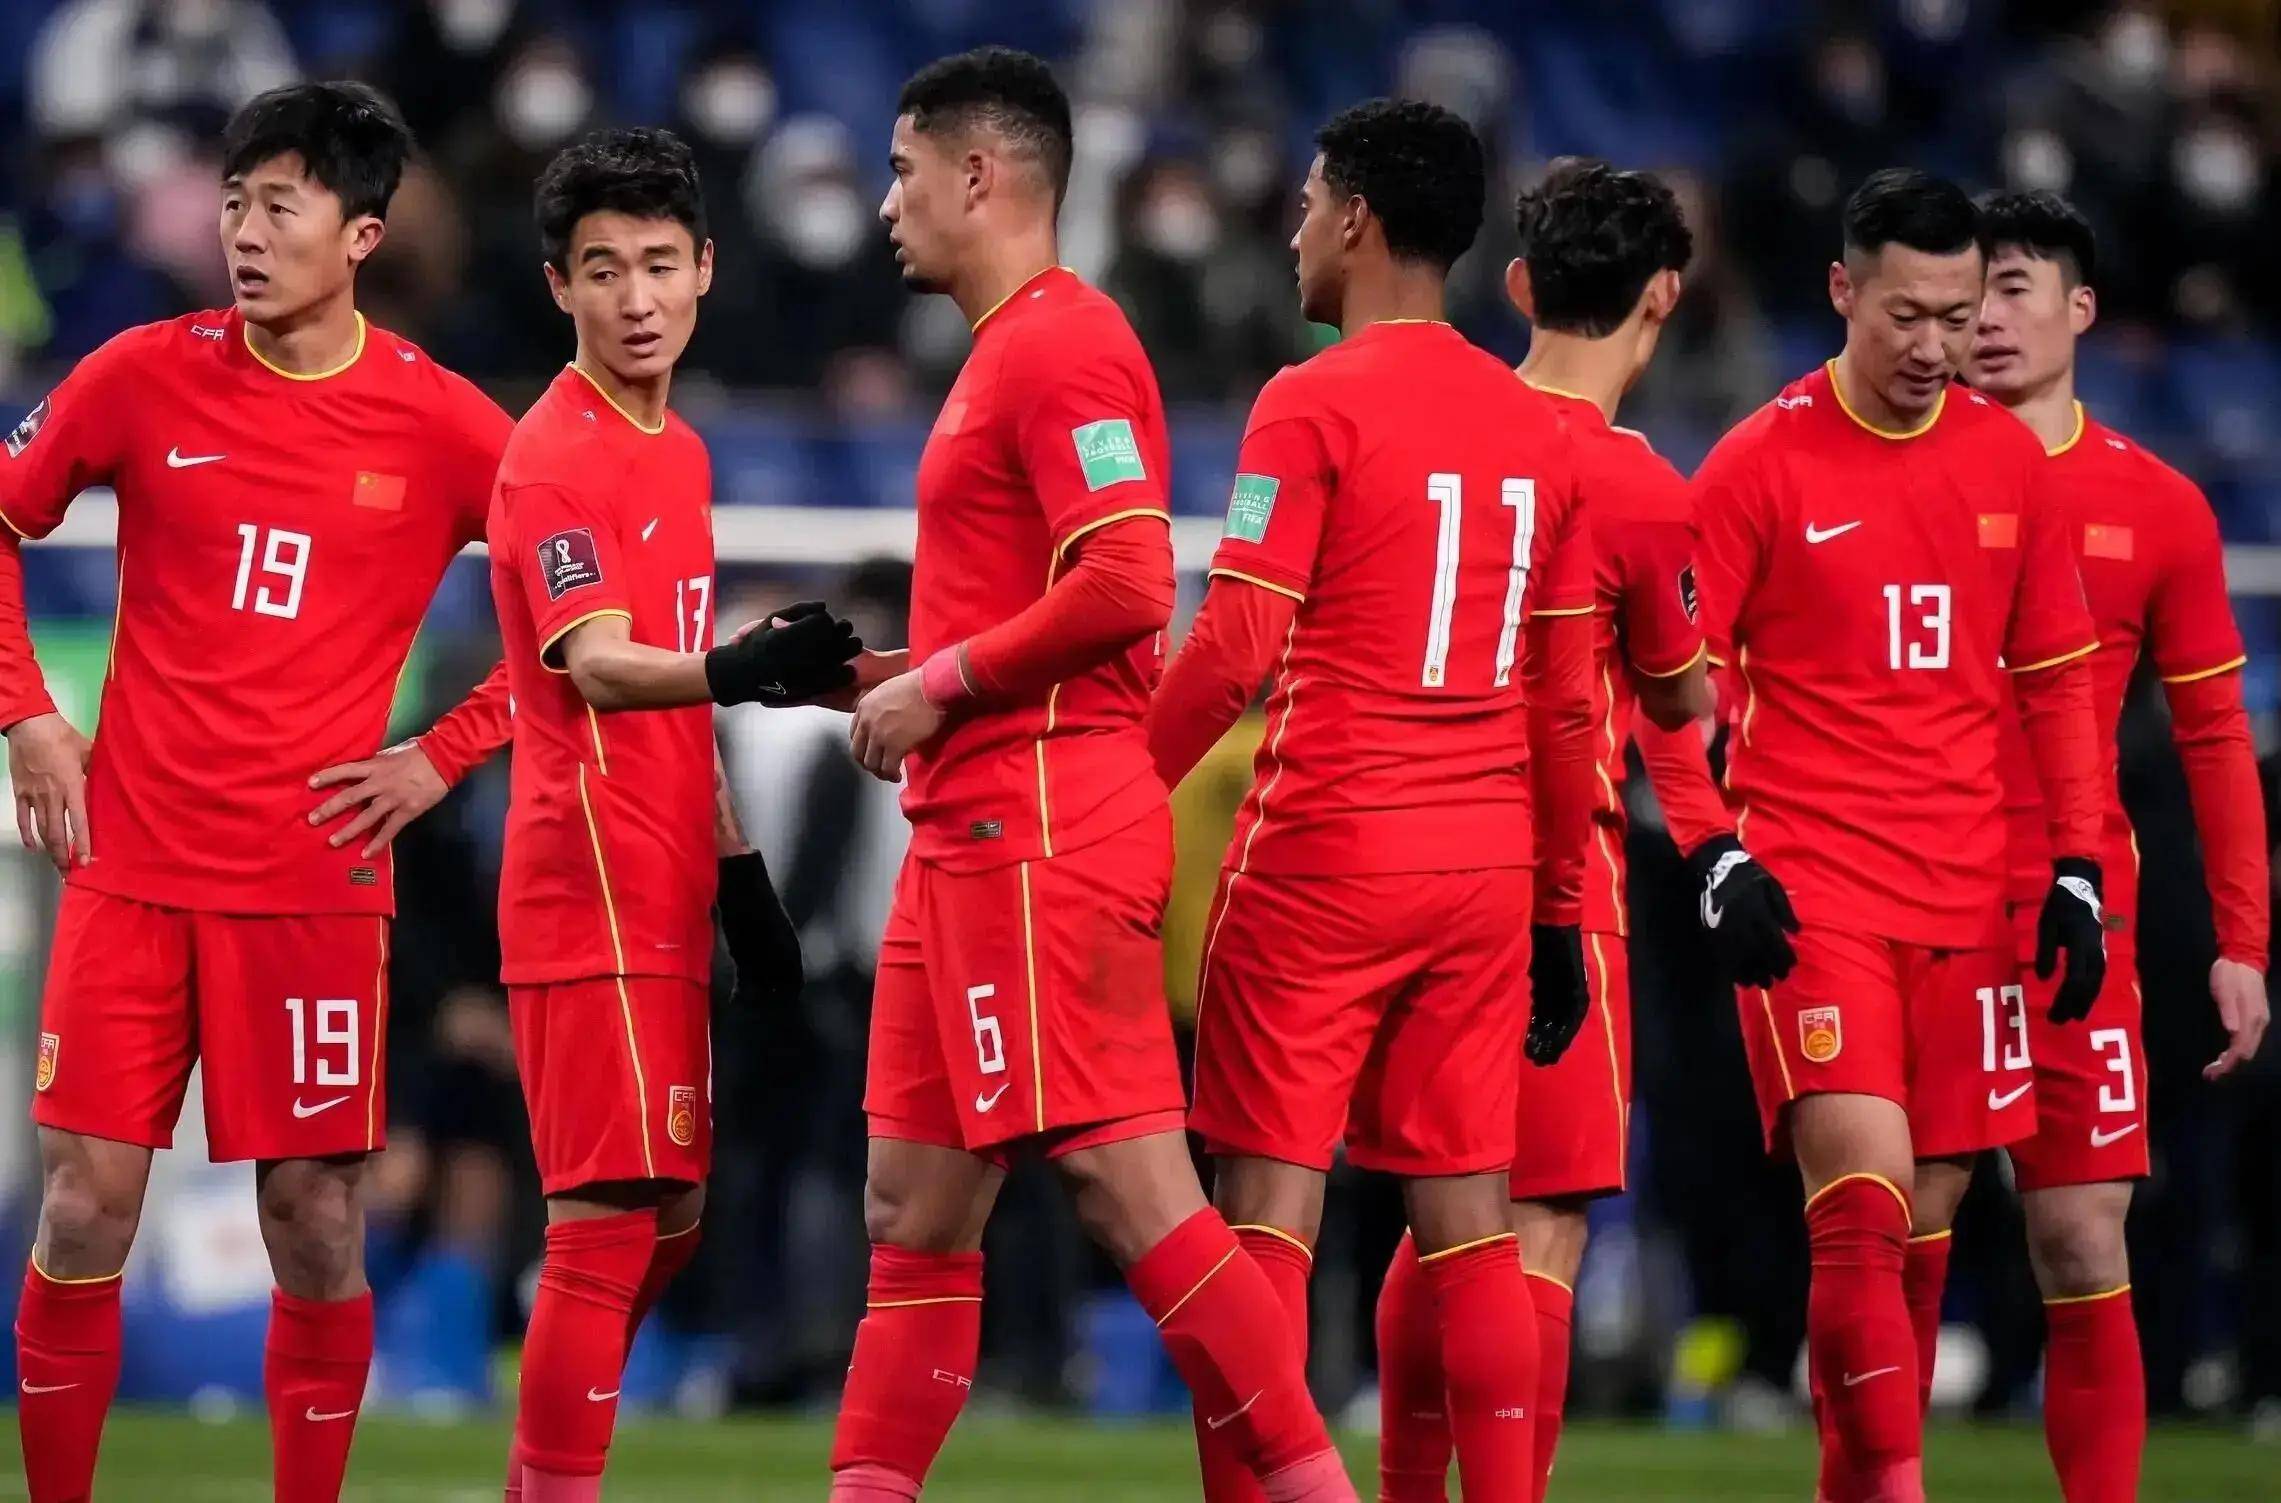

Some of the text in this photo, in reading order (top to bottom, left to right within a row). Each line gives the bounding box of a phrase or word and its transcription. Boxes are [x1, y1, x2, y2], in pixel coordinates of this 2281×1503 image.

[191, 324, 225, 341] CFA
[231, 523, 311, 620] 19
[676, 575, 711, 654] 17
[1422, 472, 1537, 688] 11
[1882, 584, 1951, 670] 13
[285, 998, 359, 1086] 19
[967, 983, 1006, 1075] 6
[1976, 984, 2032, 1072] 13
[2090, 1028, 2136, 1113] 3
